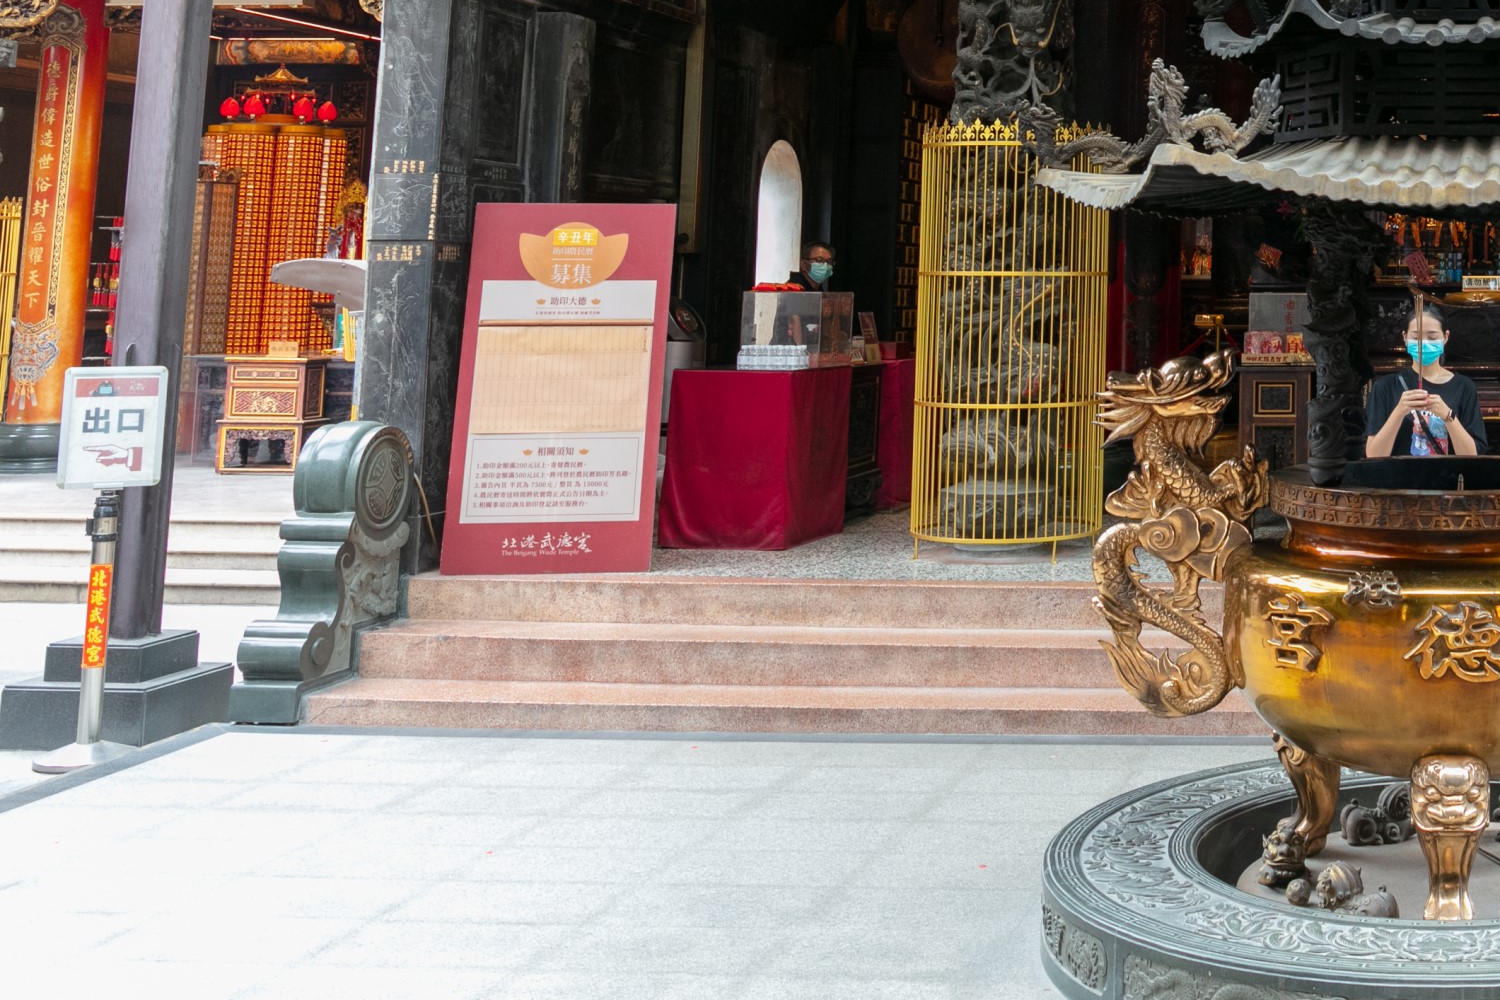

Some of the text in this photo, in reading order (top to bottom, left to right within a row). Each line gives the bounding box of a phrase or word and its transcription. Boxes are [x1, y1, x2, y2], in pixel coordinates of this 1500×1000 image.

[557, 231, 595, 244] 辛丑年
[551, 263, 592, 285] 募集
[550, 296, 587, 306] 助印大德
[82, 407, 145, 434] 出口
[537, 446, 575, 457] 相關須知
[513, 549, 537, 557] Beigang
[86, 569, 108, 663] 北港武德宮
